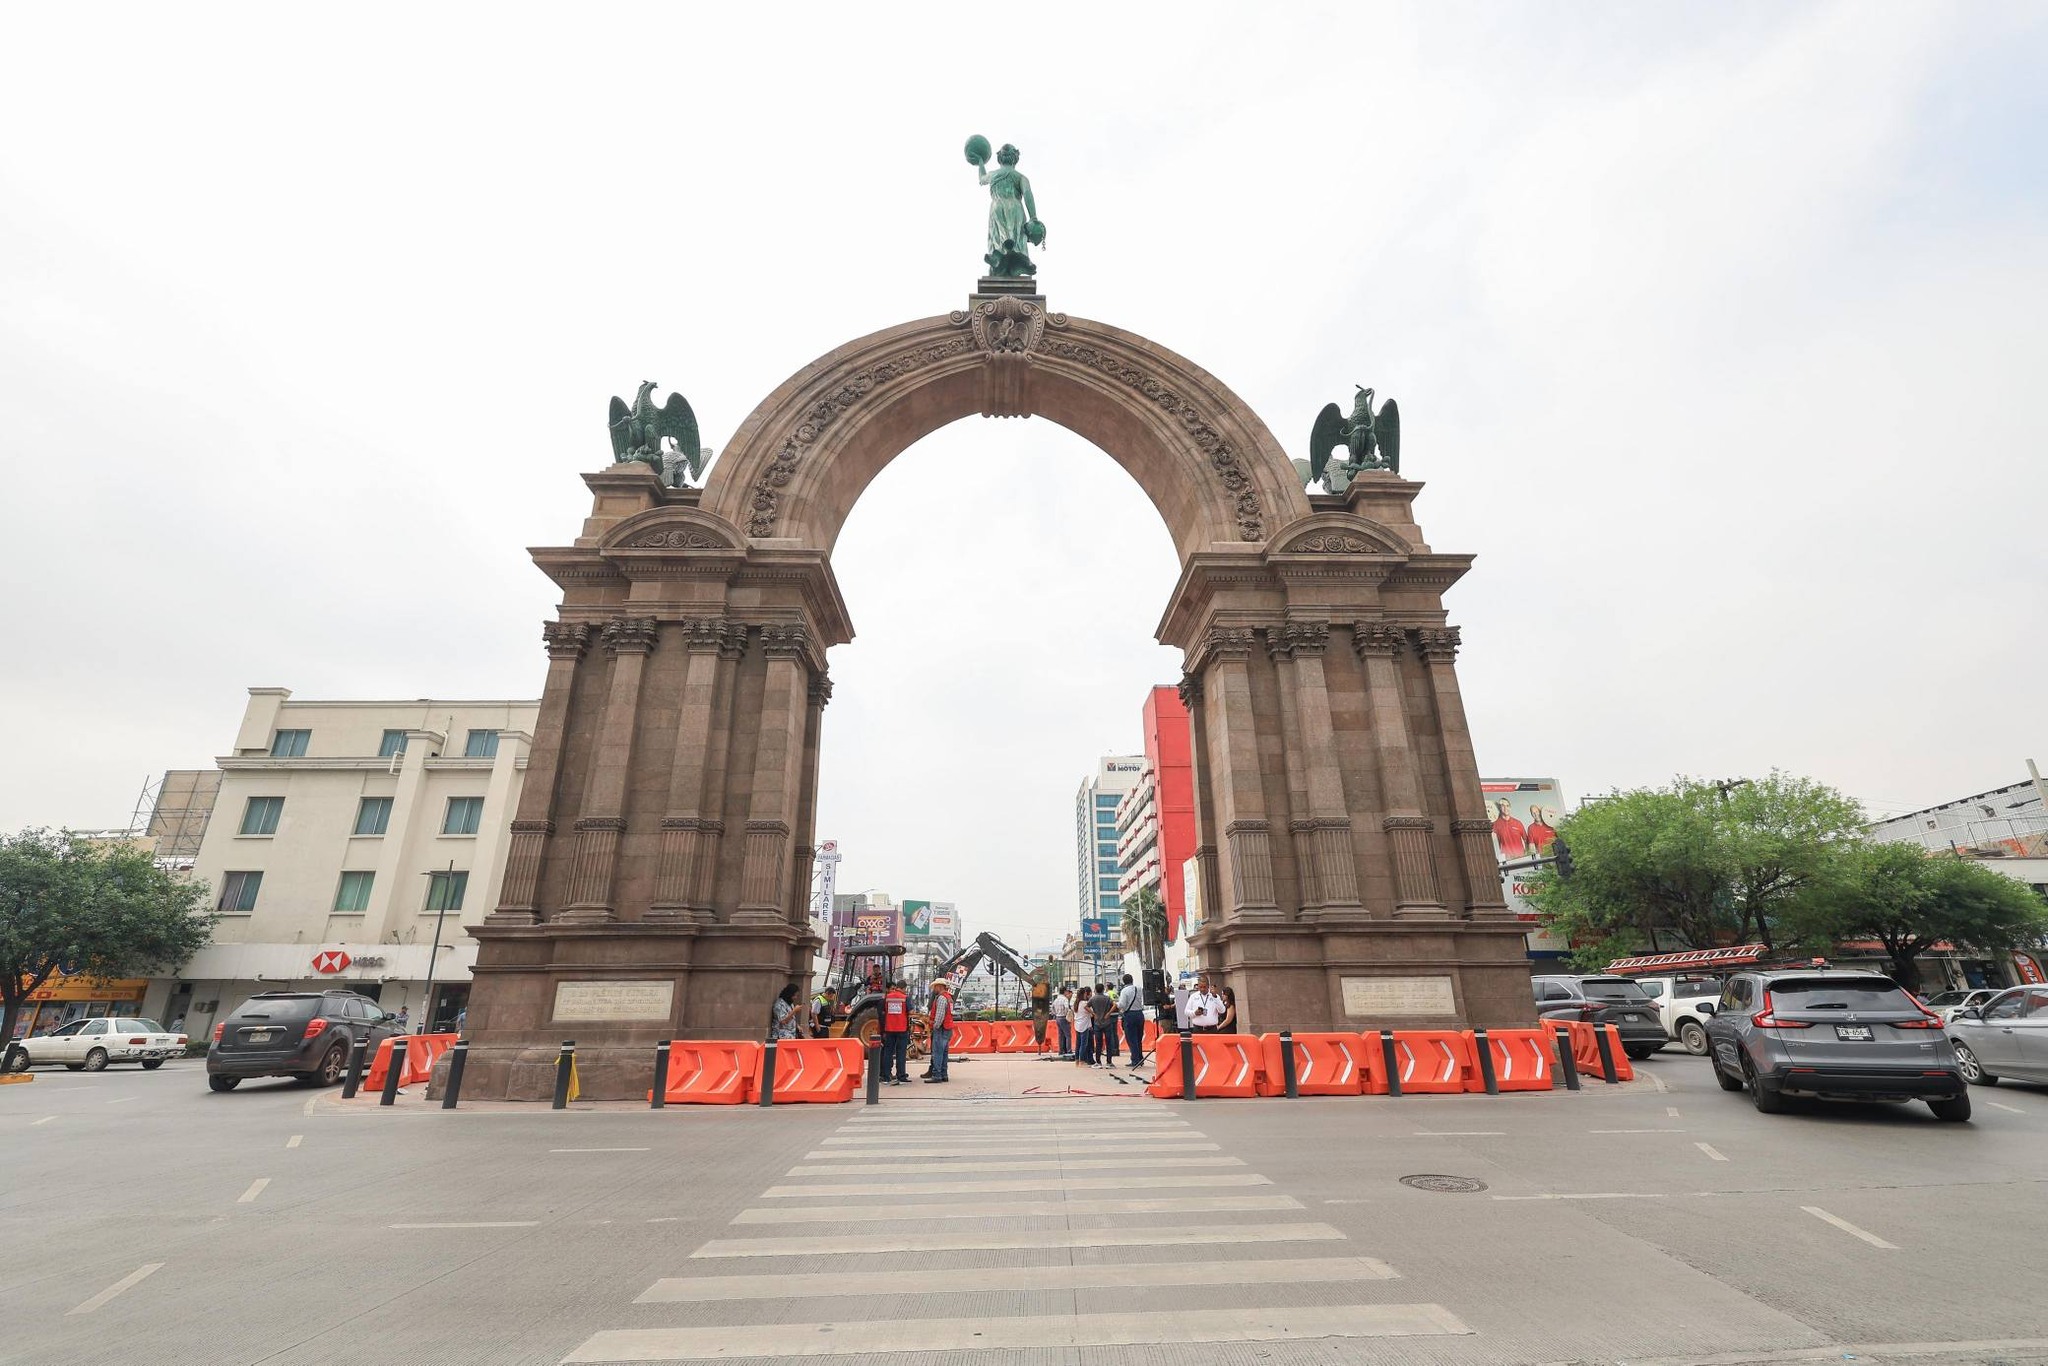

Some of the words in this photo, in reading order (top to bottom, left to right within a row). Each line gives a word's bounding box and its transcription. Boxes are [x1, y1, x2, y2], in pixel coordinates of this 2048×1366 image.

[822, 863, 831, 923] SIMILARES
[858, 919, 886, 929] OXXO
[352, 956, 386, 968] HSBC
